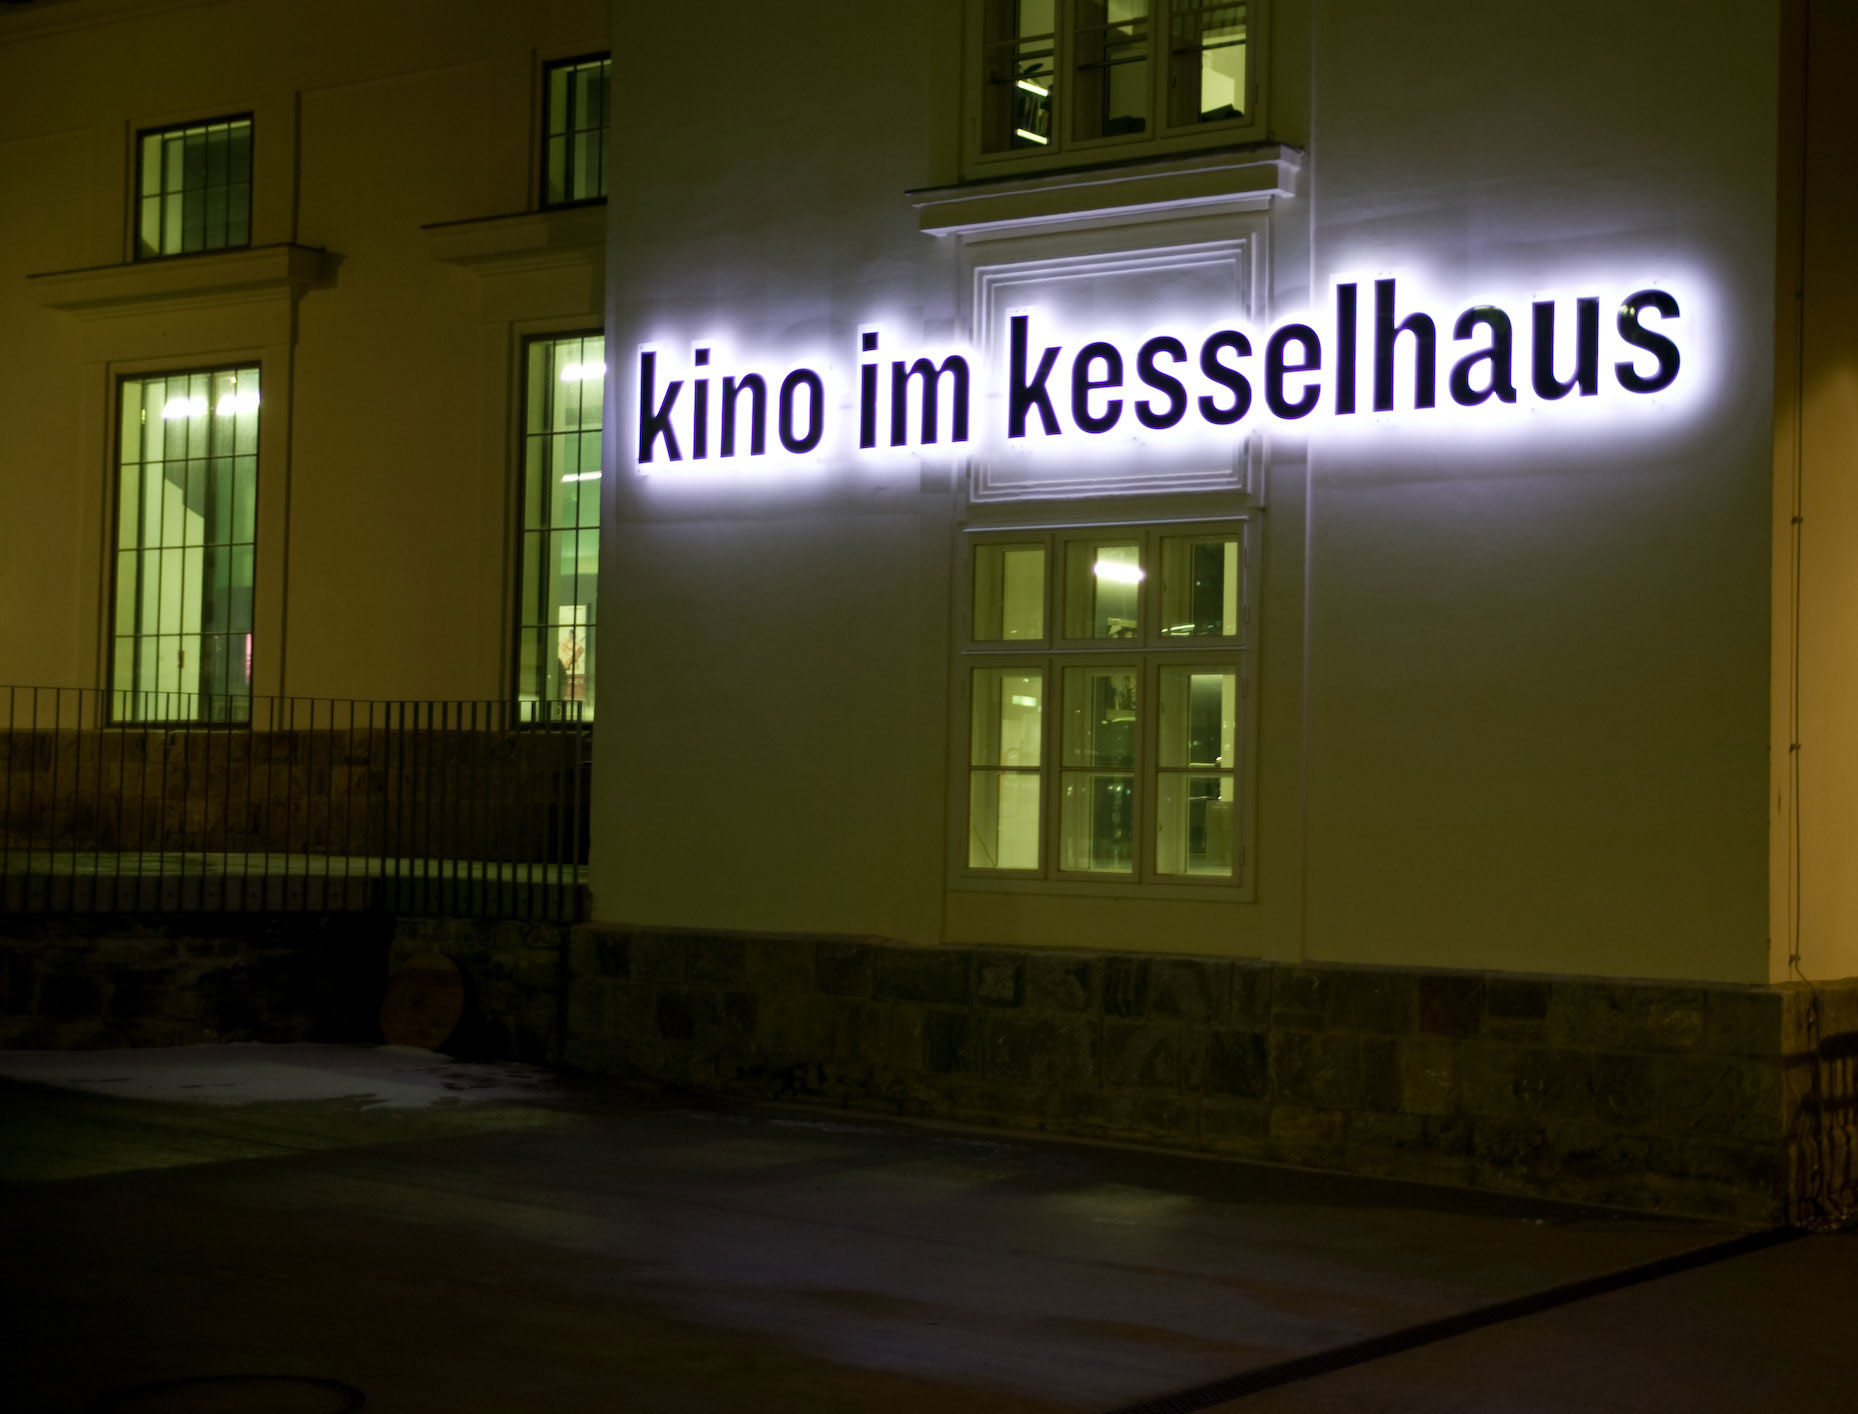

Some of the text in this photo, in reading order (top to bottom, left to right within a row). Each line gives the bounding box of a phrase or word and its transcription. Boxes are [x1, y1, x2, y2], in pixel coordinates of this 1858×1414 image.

[638, 278, 1681, 464] kino im kesselhaus
